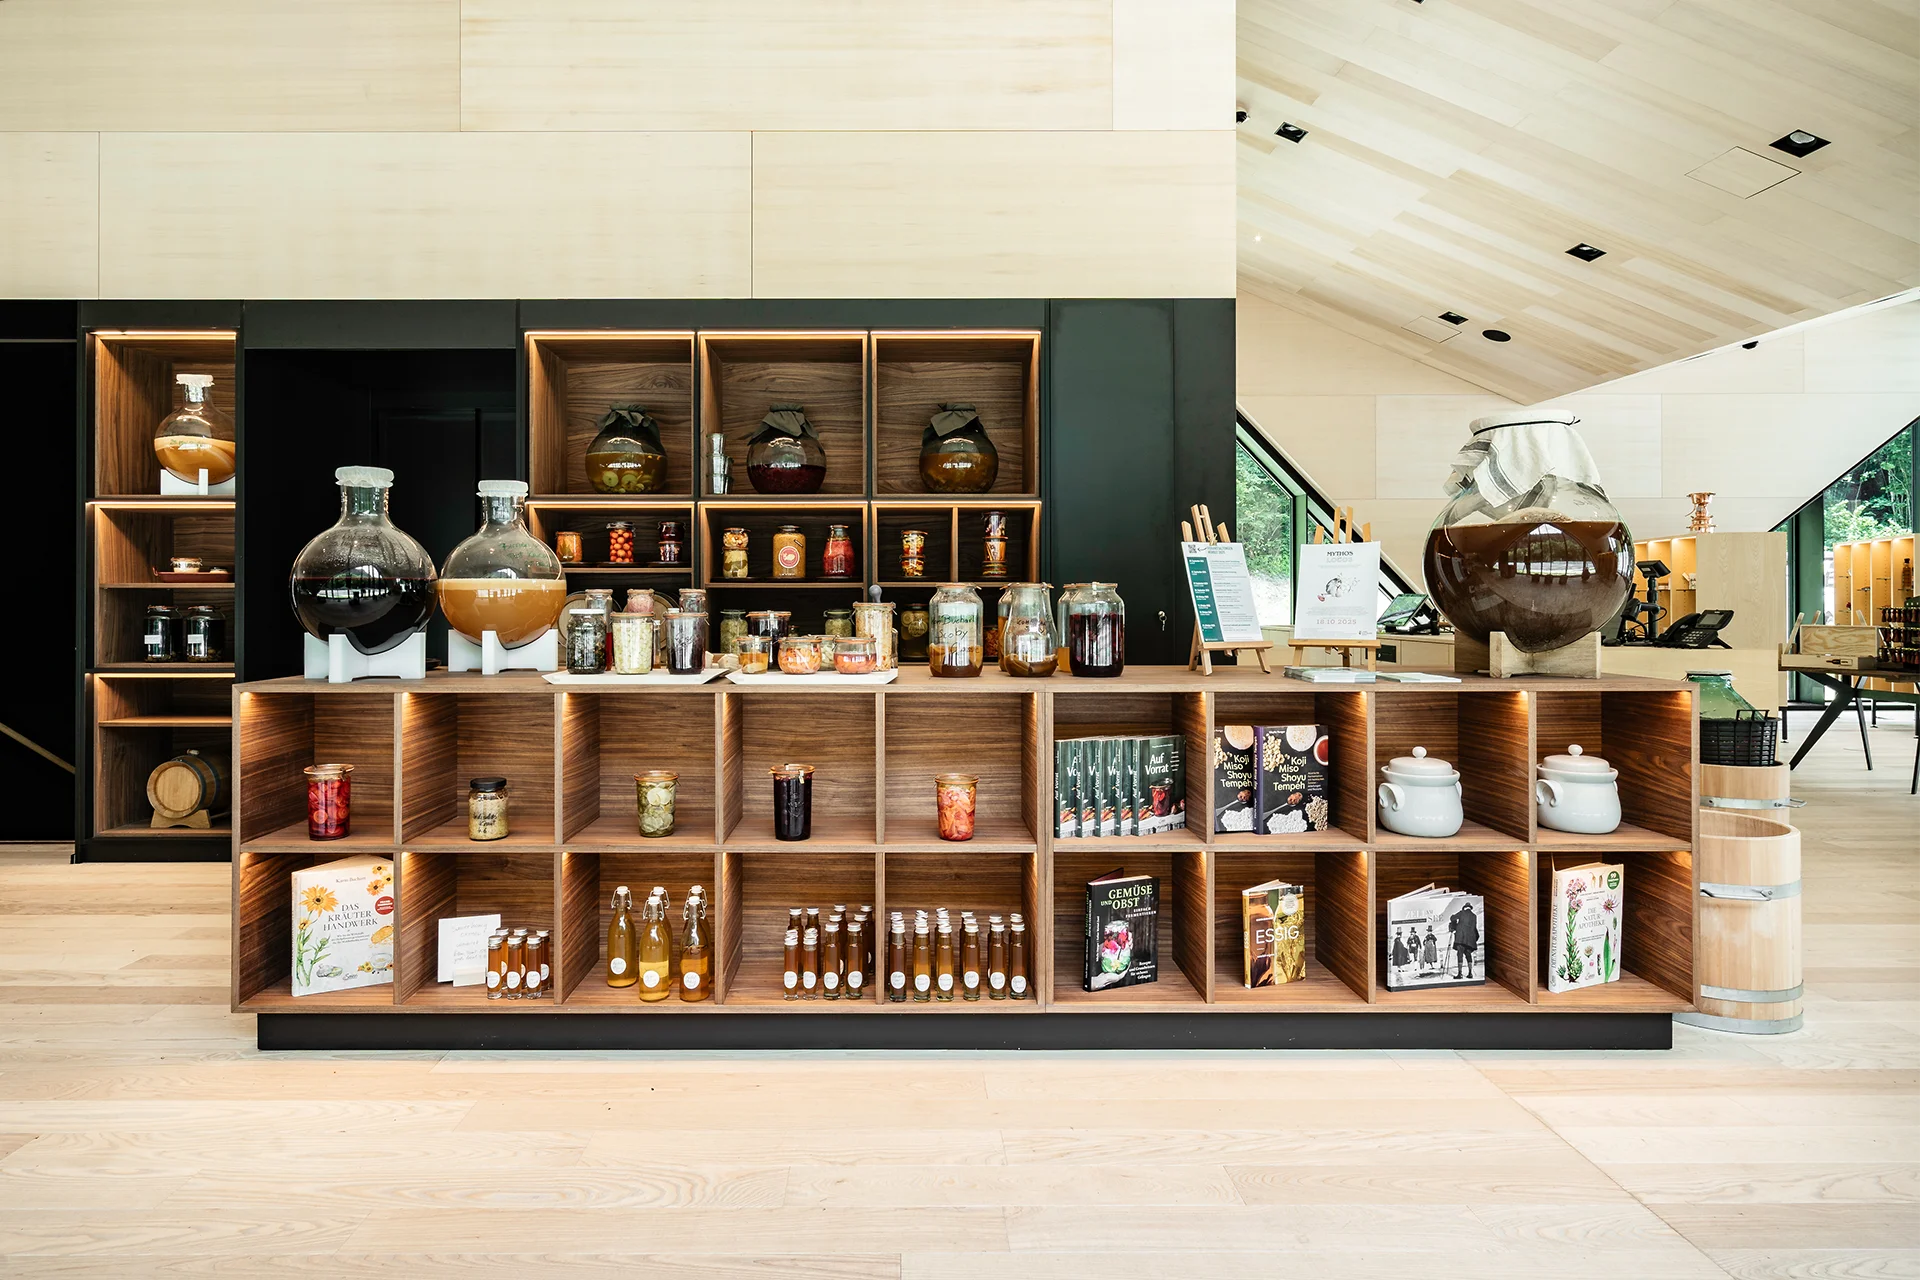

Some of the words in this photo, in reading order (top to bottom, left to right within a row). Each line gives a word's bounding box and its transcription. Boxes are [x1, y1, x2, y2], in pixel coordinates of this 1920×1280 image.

[1149, 752, 1165, 765] Auf
[1233, 754, 1250, 765] Koji
[1291, 756, 1307, 766] Koji
[1144, 763, 1170, 776] Vorrat
[1223, 762, 1244, 770] Miso
[1278, 764, 1300, 773] Miso
[1226, 770, 1253, 781] Shoyu
[1280, 773, 1307, 784] Shoyu
[1220, 778, 1253, 790] Tempeh
[1273, 781, 1306, 792] Tempeh
[1108, 885, 1153, 900] GEMÜSE
[341, 902, 360, 912] DAS
[1112, 897, 1141, 910] OBST
[327, 910, 372, 922] KRÄUTER
[1587, 906, 1597, 915] DIE
[323, 918, 378, 932] HANDWERK
[1577, 919, 1606, 930] APOTHEKE
[1255, 925, 1300, 945] ESSIG
